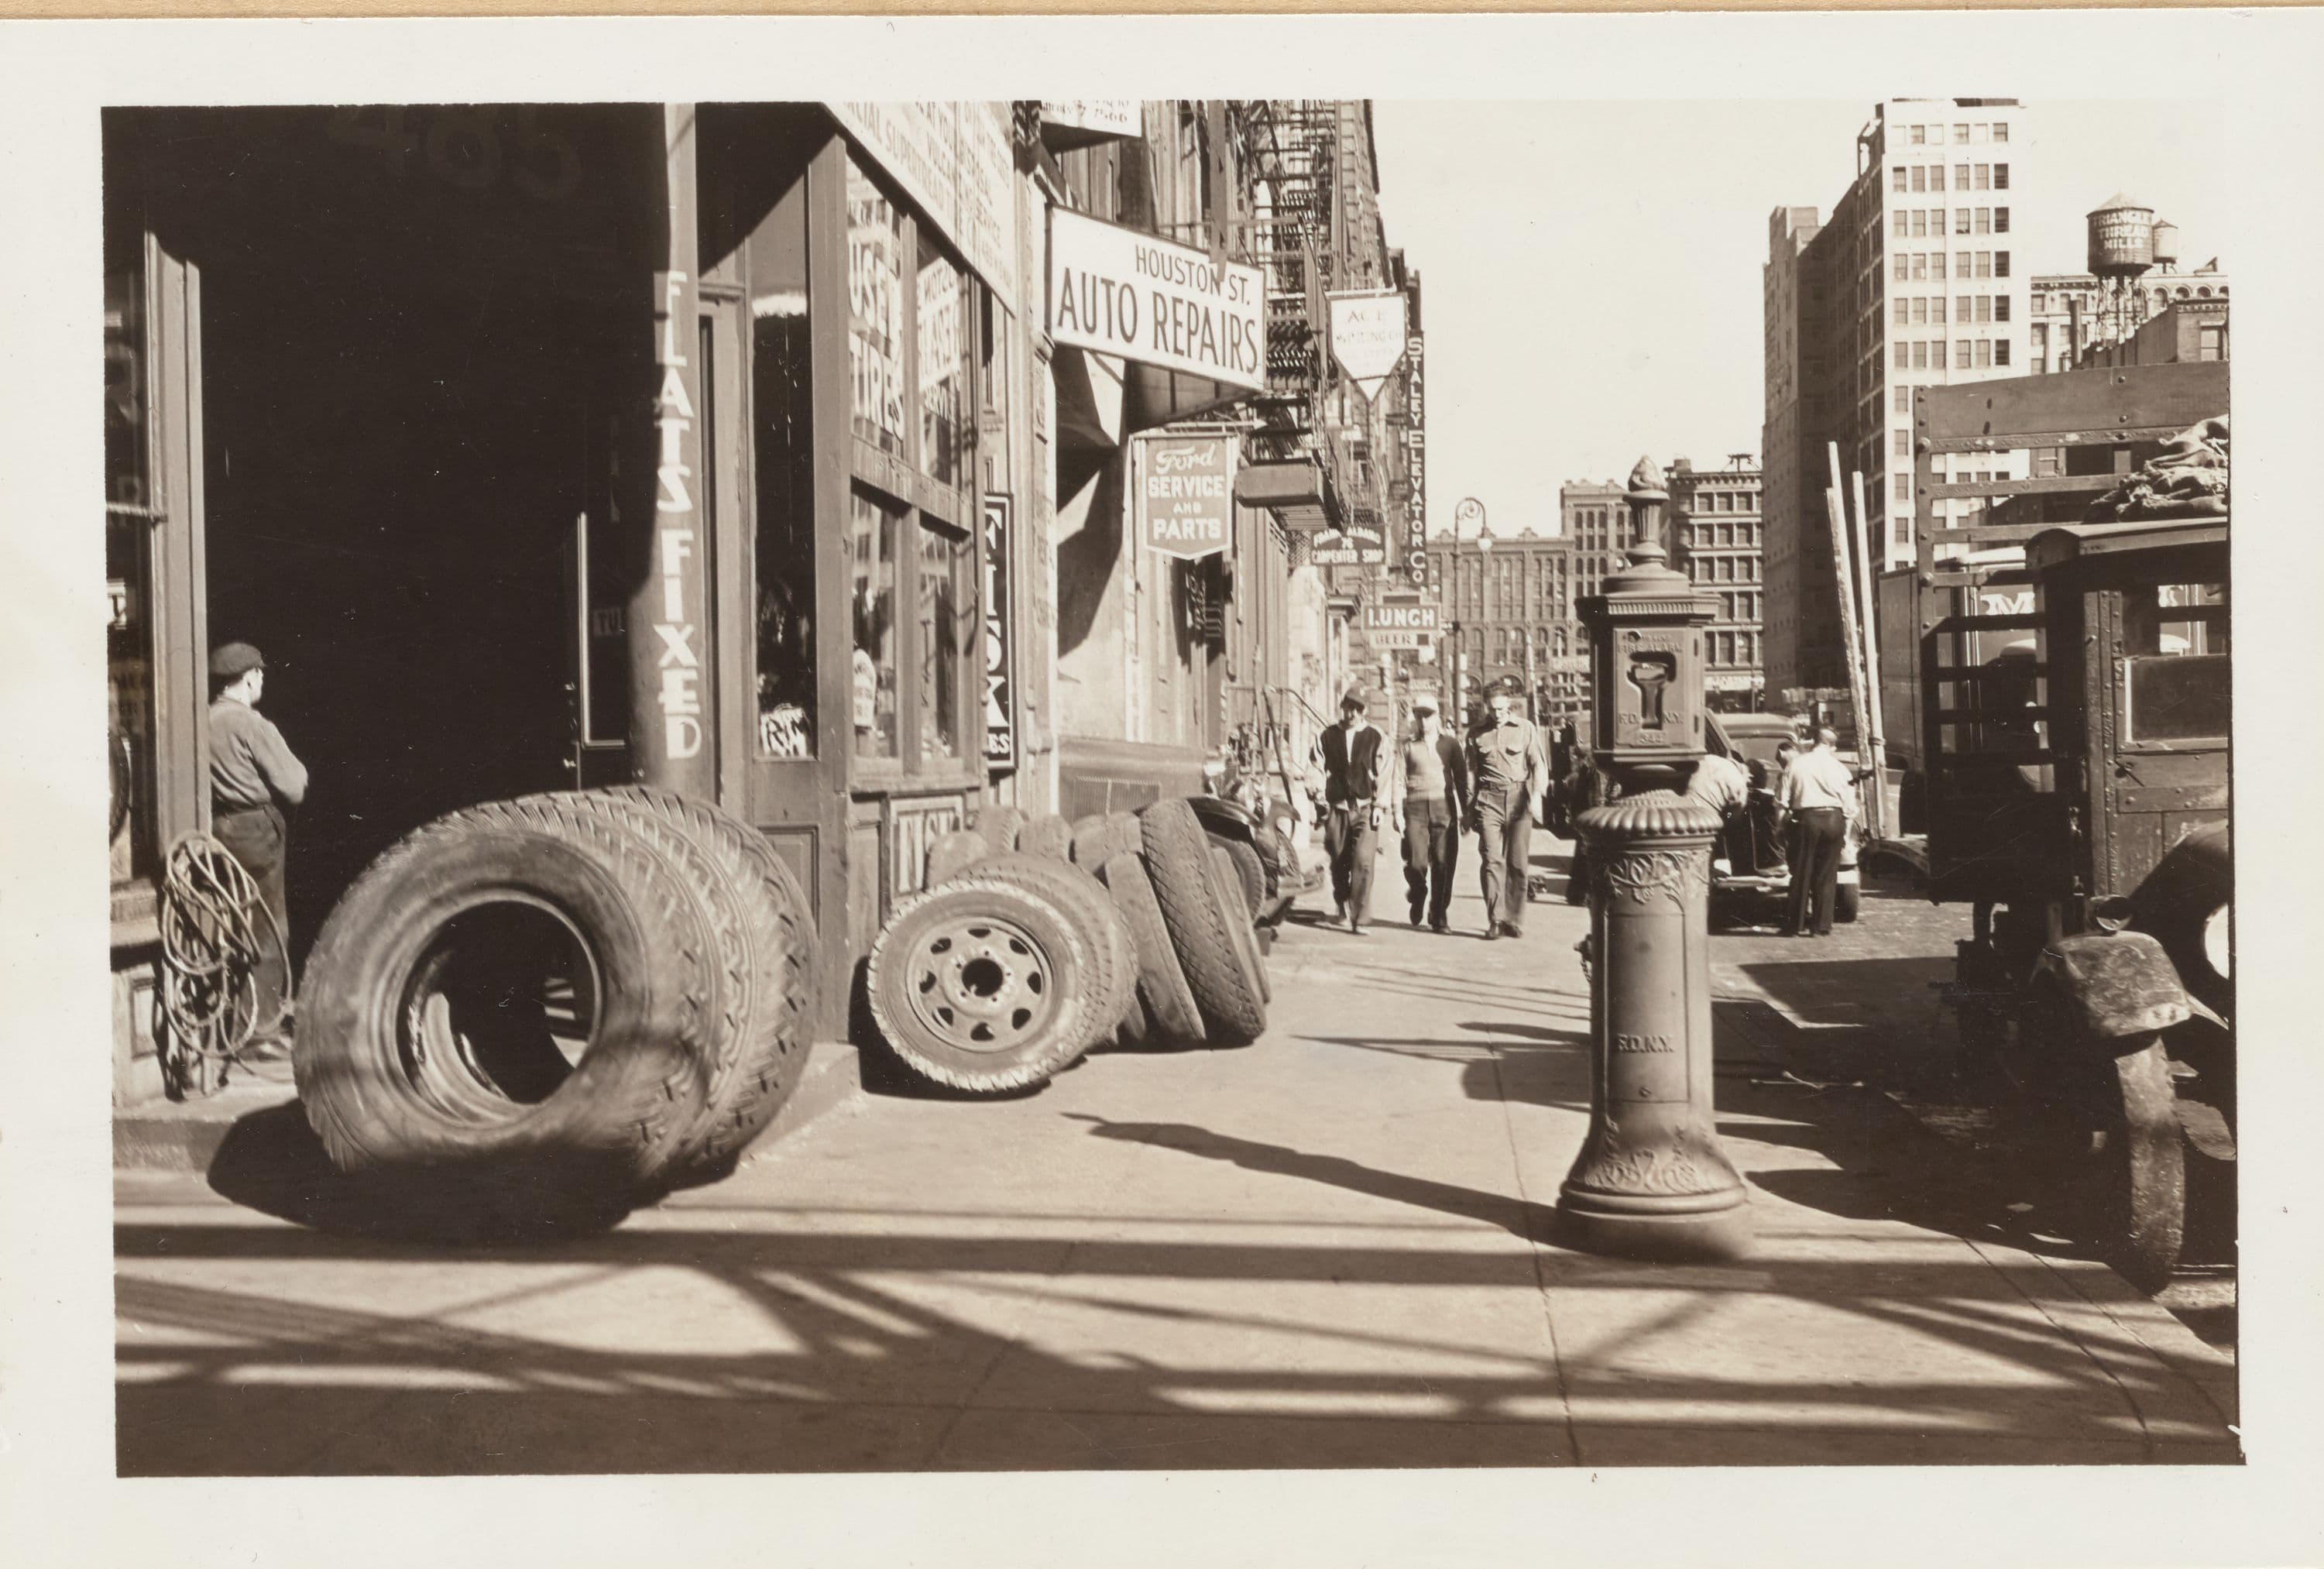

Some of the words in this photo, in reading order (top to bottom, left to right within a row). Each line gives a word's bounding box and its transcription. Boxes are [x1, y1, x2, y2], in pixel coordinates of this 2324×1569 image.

[2093, 211, 2151, 225] TRIANGLE
[2099, 225, 2149, 239] THREAD
[2104, 239, 2144, 250] MILLS
[1135, 244, 1222, 297] HOUSTON
[1228, 277, 1251, 307] ST.
[1058, 267, 1138, 343] AUTO
[1152, 291, 1261, 375] REPAIRS
[654, 270, 695, 513] FLATS
[849, 331, 905, 441] TIRES
[1408, 337, 1424, 427] STALEY
[1155, 442, 1216, 475] Ford
[1148, 476, 1225, 498] SERVICE
[1408, 429, 1425, 548] ELEVATOR
[1172, 501, 1203, 514] AND
[1152, 518, 1222, 540] PARTS
[1311, 549, 1358, 564] CARPENTER
[1368, 608, 1435, 627] LUNCH
[653, 529, 702, 760] FIXED
[1375, 634, 1412, 645] BEER
